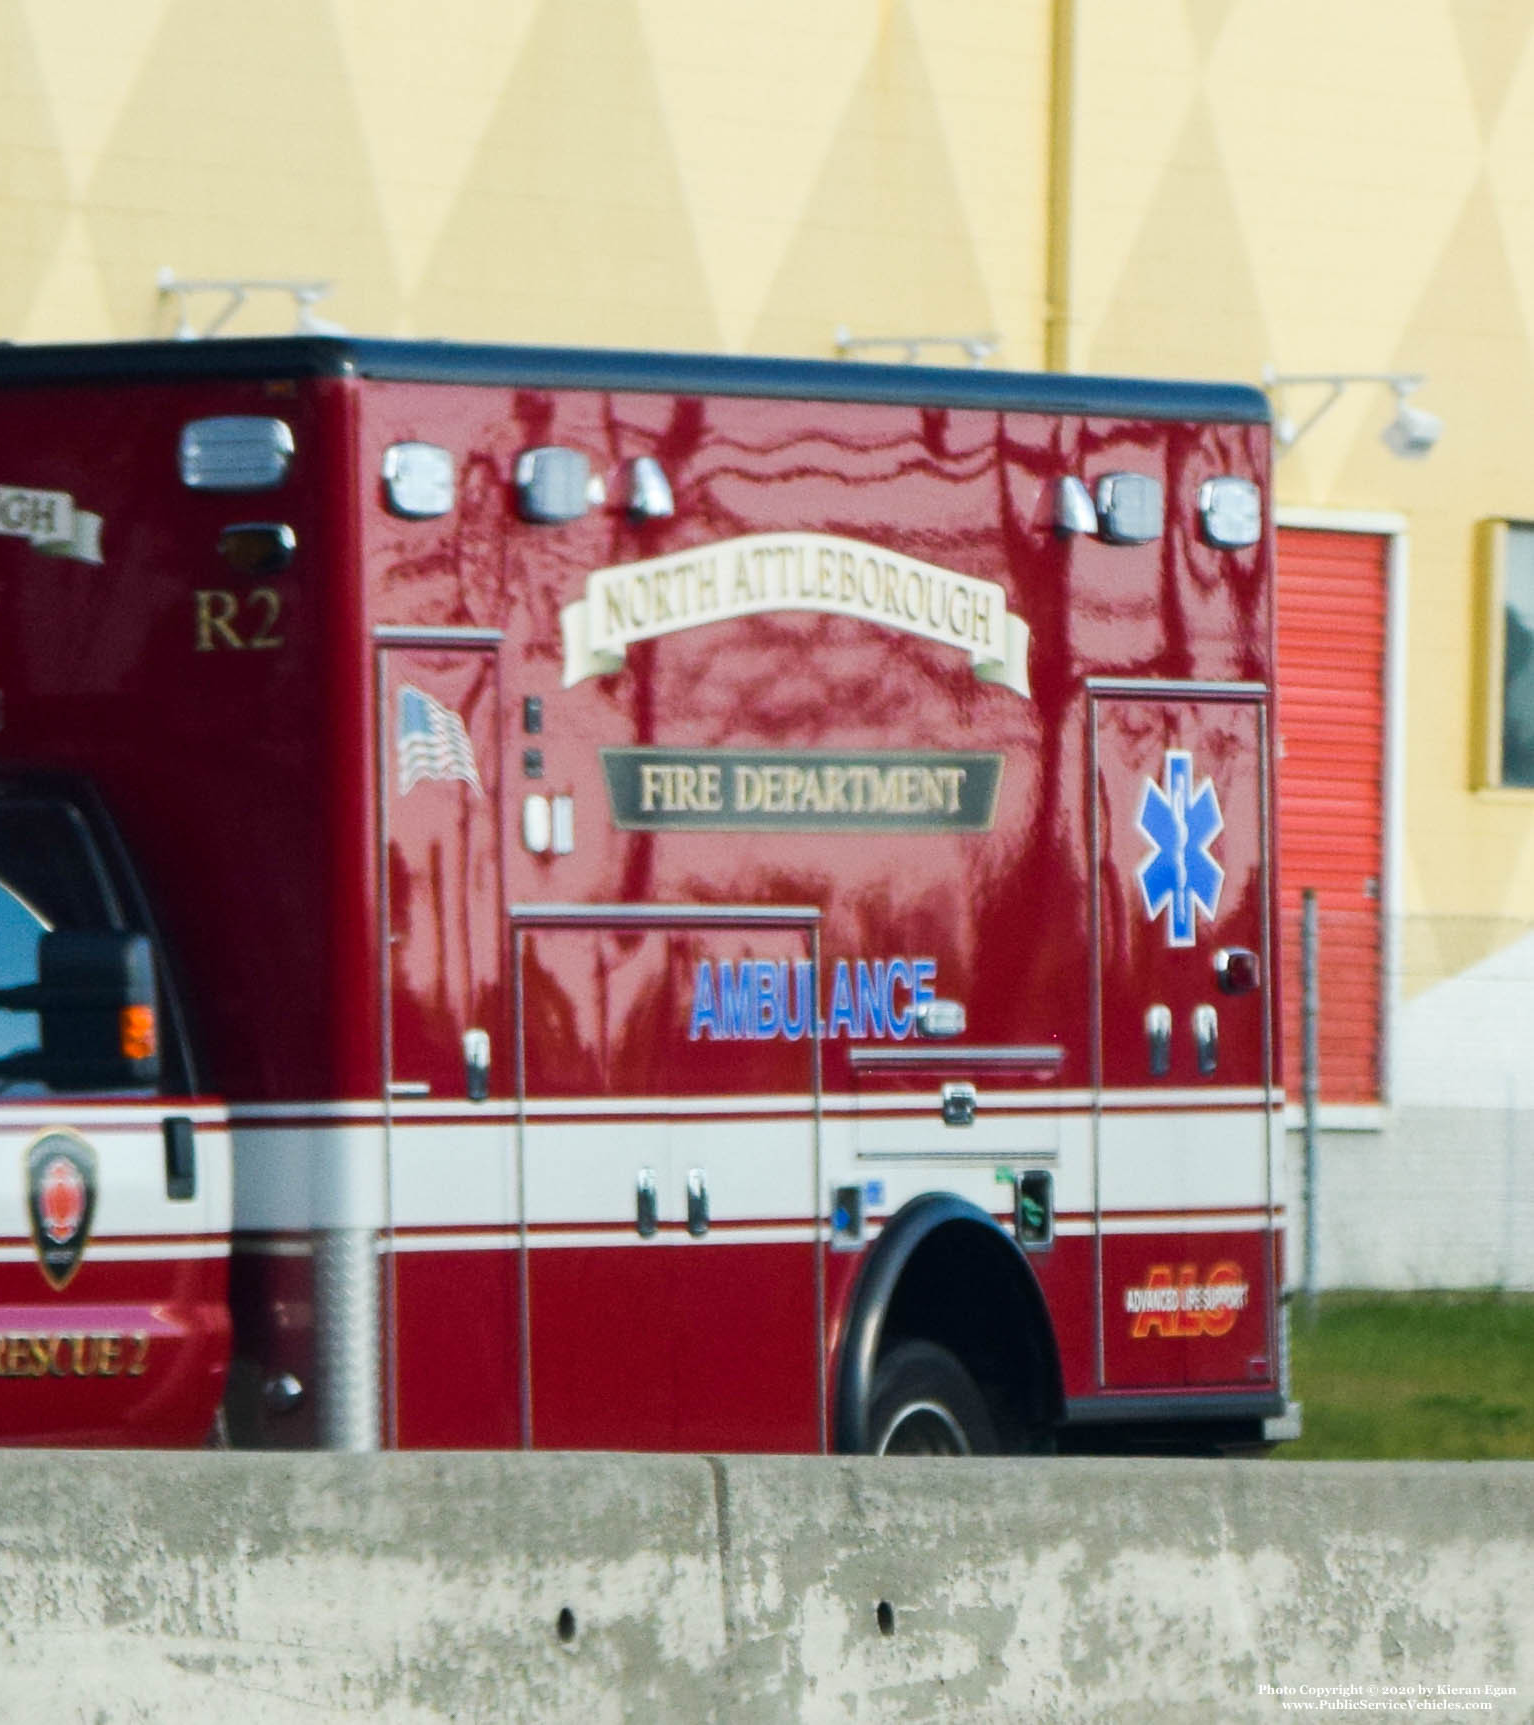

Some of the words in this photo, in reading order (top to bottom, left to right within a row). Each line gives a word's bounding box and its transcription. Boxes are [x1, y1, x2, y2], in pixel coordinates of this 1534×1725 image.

[193, 588, 285, 651] R2
[602, 561, 718, 636] NORTH
[732, 543, 994, 647] ATTLEBOROUGH
[639, 763, 723, 814] FIRE
[733, 763, 967, 815] DEPARTMENT
[1125, 1287, 1179, 1312] ADVANCED
[126, 1329, 149, 1377] 2
